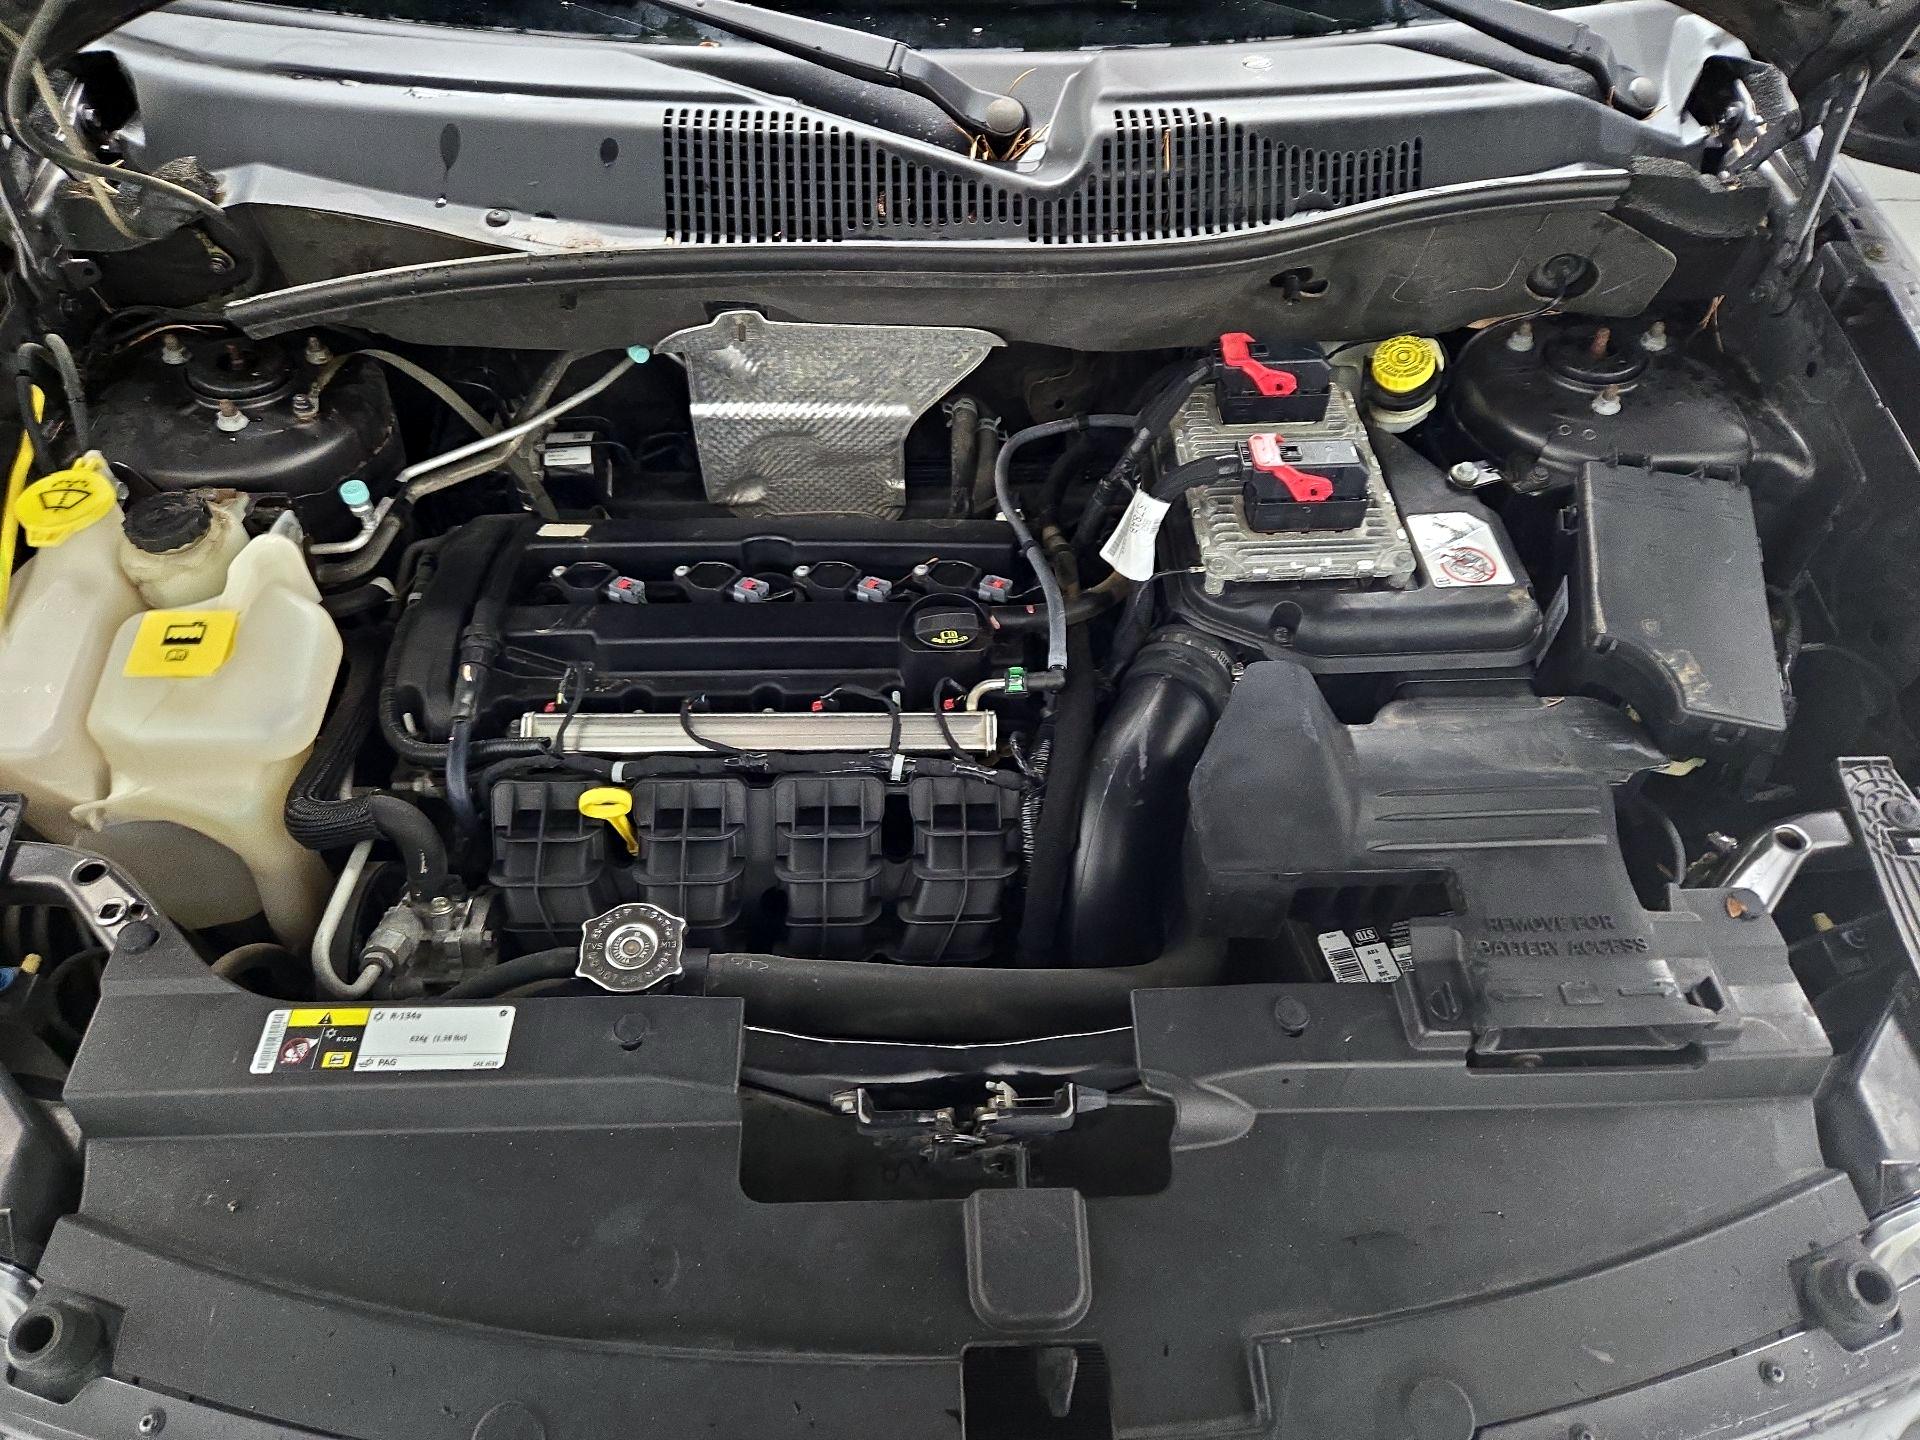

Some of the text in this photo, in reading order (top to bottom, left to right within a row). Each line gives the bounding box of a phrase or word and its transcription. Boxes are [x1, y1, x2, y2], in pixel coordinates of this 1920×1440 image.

[1486, 914, 1616, 932] REMOVE FOR
[1479, 937, 1648, 957] BATTERY ACCESS
[390, 1011, 422, 1021] R-134a
[378, 1058, 397, 1066] PAG
